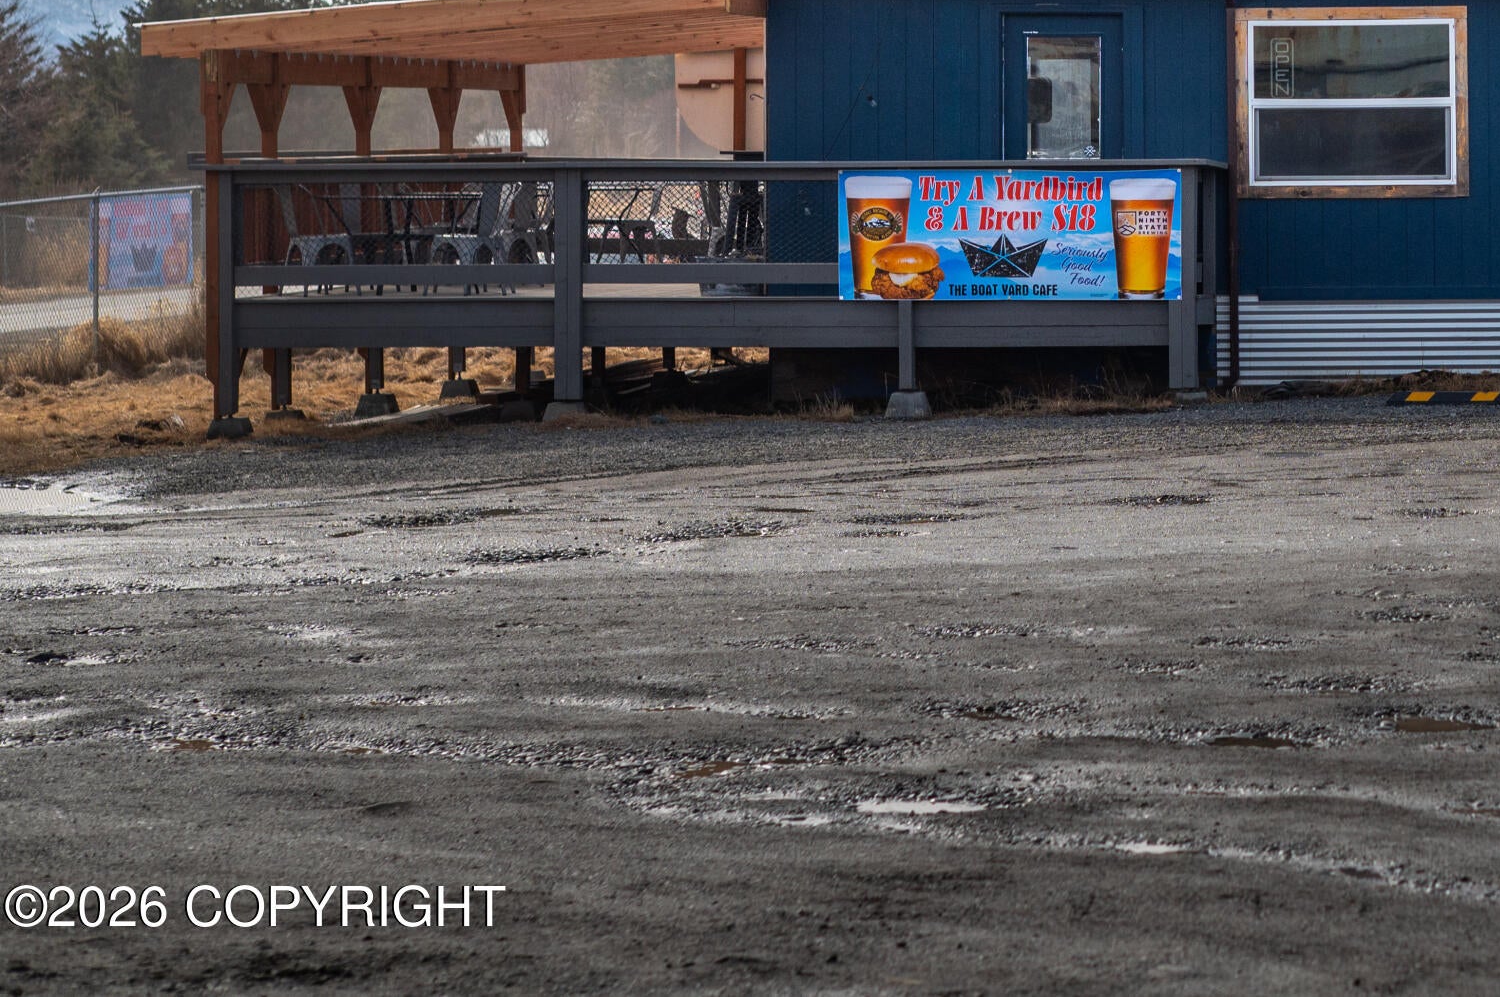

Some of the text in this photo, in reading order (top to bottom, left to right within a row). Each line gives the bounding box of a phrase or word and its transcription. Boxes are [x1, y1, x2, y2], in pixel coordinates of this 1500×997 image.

[1275, 42, 1290, 97] OPEN
[918, 175, 1104, 206] Try A Yardbird
[924, 206, 944, 231] &
[952, 206, 970, 231] A
[978, 206, 1043, 231] Brew
[1051, 202, 1097, 233] $18
[1051, 242, 1108, 263] Seriously
[1061, 256, 1094, 272] Good
[948, 283, 1058, 296] THE BOAT YARD CAFE
[1070, 272, 1106, 287] Food!
